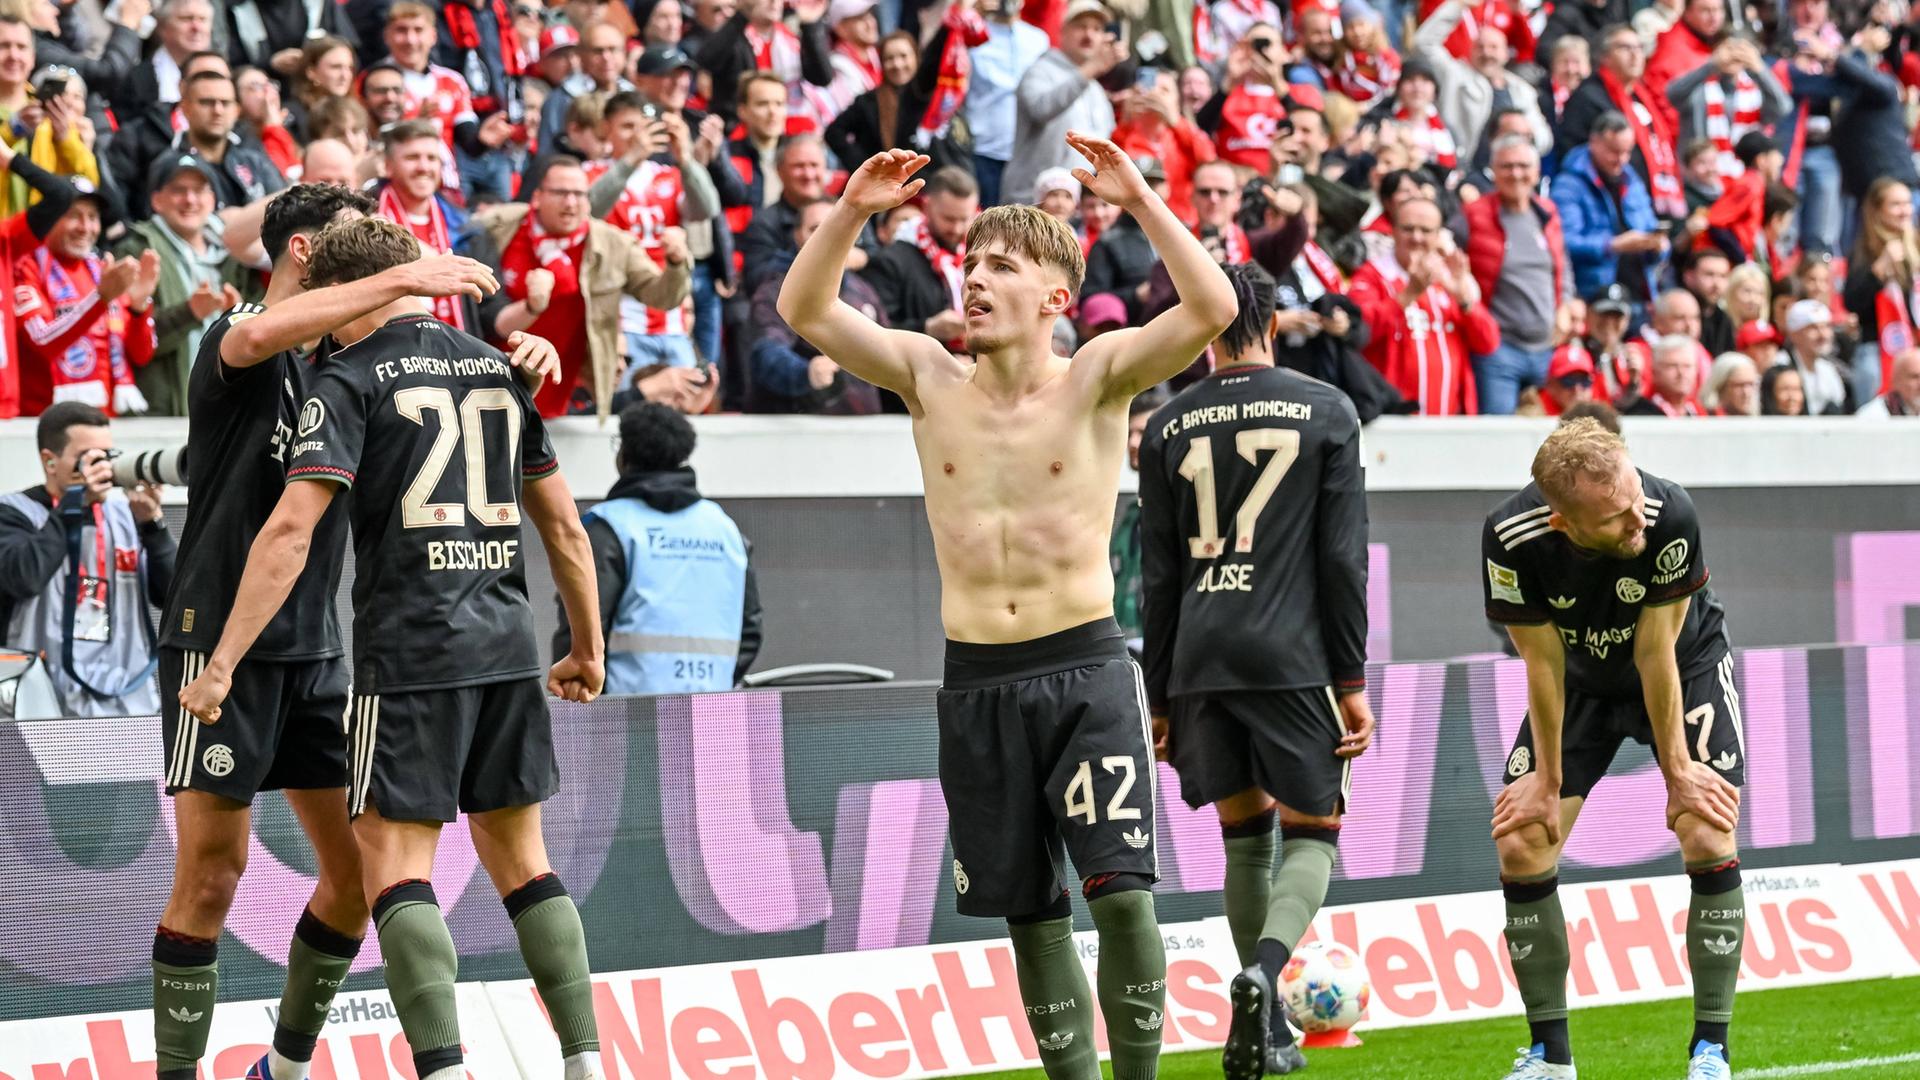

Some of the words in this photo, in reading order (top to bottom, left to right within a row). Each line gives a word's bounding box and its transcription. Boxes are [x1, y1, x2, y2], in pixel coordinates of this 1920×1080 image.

[376, 362, 399, 382] FC
[400, 356, 451, 376] BAYERN
[1163, 419, 1180, 440] FC
[1183, 403, 1238, 431] BAYERN
[1243, 399, 1312, 421] MÜNCHEN
[394, 386, 522, 529] 20
[1178, 428, 1300, 559] 17
[427, 539, 519, 571] BISCHOF
[1584, 623, 1636, 647] MAGE
[1584, 643, 1609, 660] TV
[674, 660, 715, 680] 2151
[1064, 755, 1142, 825] 42
[1700, 908, 1744, 920] FCBM
[161, 979, 211, 992] FCBM
[1025, 998, 1077, 1016] FCBM
